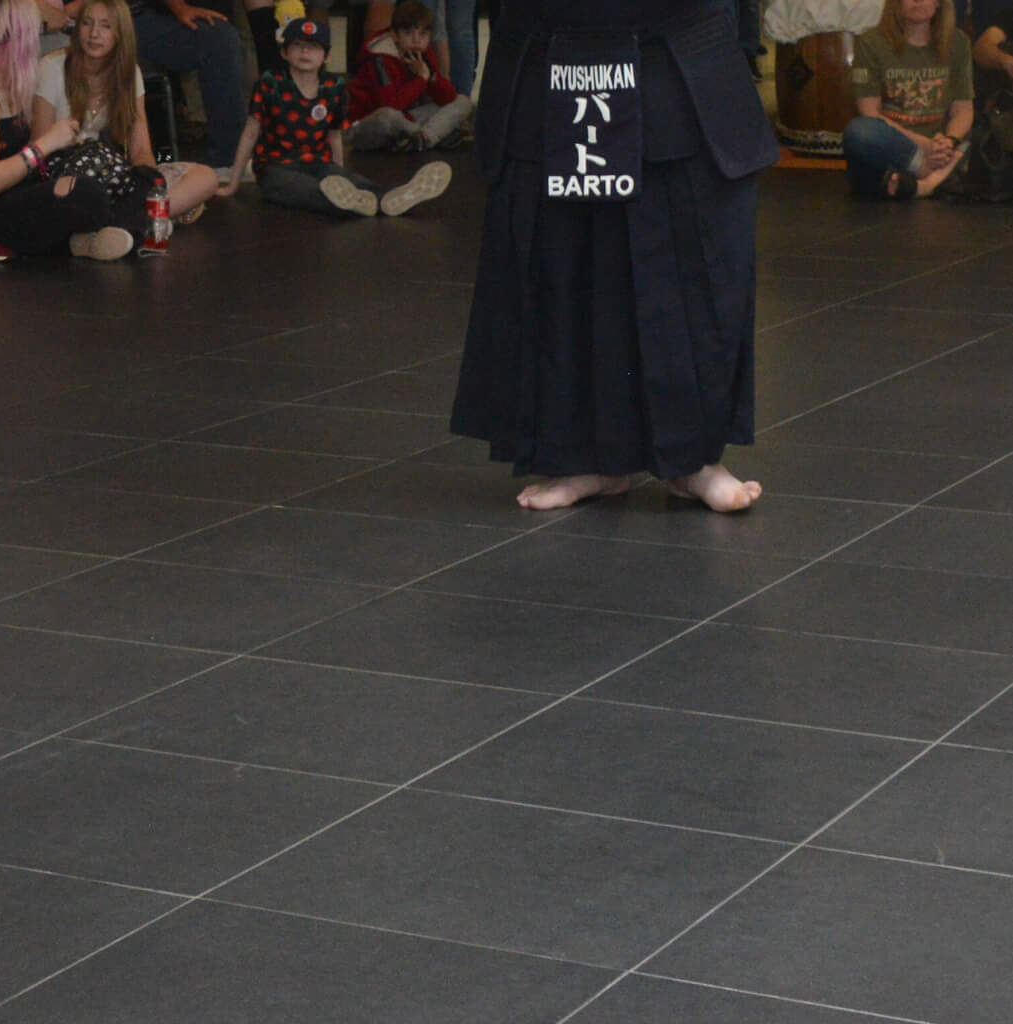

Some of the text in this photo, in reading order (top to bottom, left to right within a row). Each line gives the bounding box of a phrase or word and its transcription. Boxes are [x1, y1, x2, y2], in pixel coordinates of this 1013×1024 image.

[550, 63, 636, 91] RYUSHUKAN
[571, 92, 611, 174] バート
[547, 175, 635, 197] BARTO
